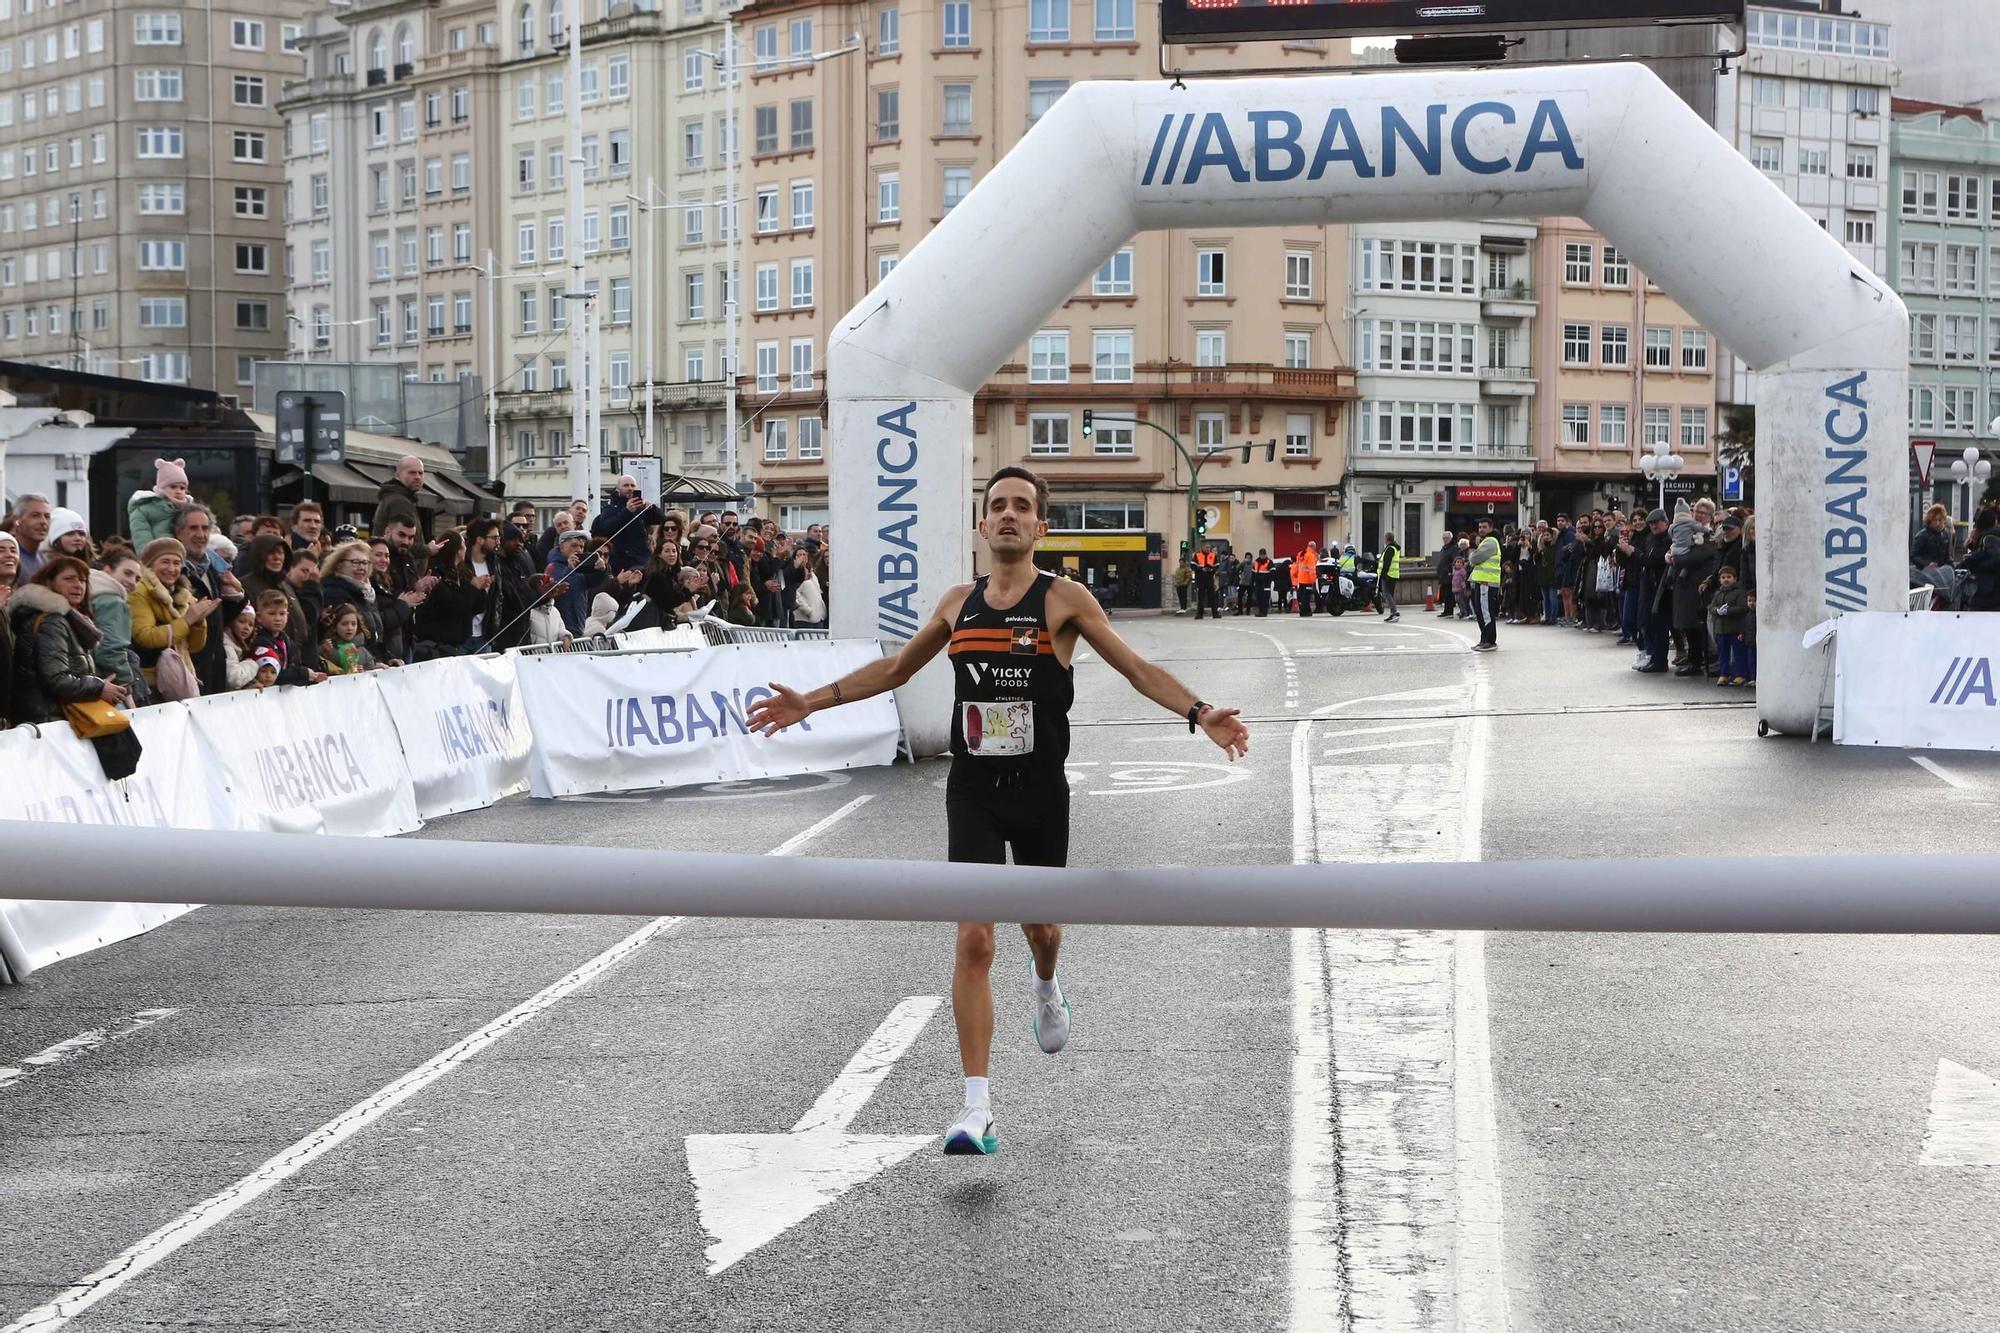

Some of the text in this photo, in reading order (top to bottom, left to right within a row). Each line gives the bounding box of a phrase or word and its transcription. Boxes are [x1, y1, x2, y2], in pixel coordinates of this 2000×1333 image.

[1183, 99, 1584, 184] ABANCA
[992, 668, 1032, 678] VICKY
[995, 679, 1029, 687] FOODS
